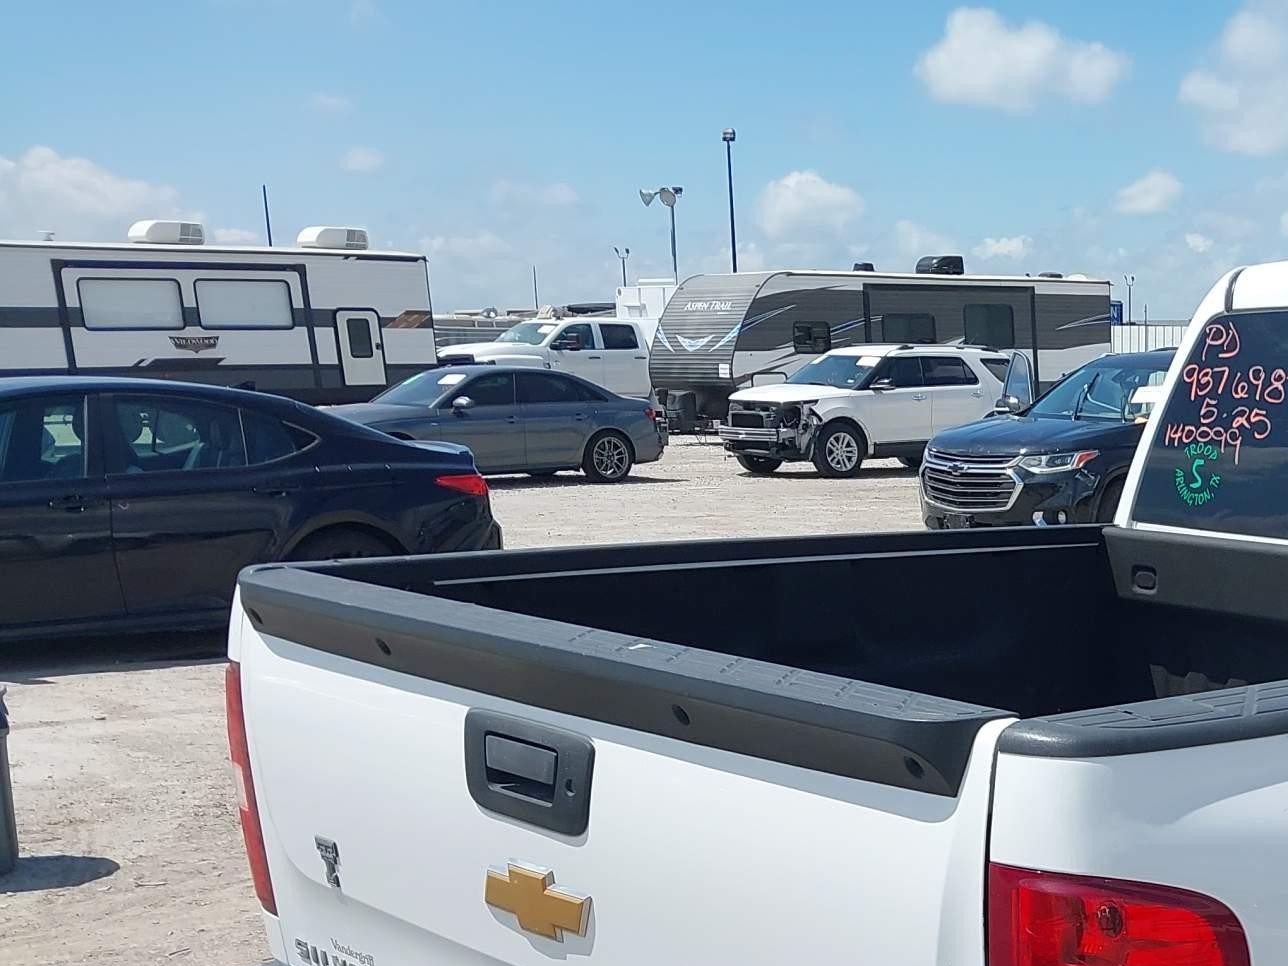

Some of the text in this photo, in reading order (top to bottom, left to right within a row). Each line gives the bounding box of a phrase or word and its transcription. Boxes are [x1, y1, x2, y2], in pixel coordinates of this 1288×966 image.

[684, 301, 733, 311] ASPEN TRAIL
[1202, 322, 1240, 361] PD
[1165, 423, 1242, 465] 140099
[1184, 442, 1218, 460] TROOP
[1209, 473, 1221, 488] TX
